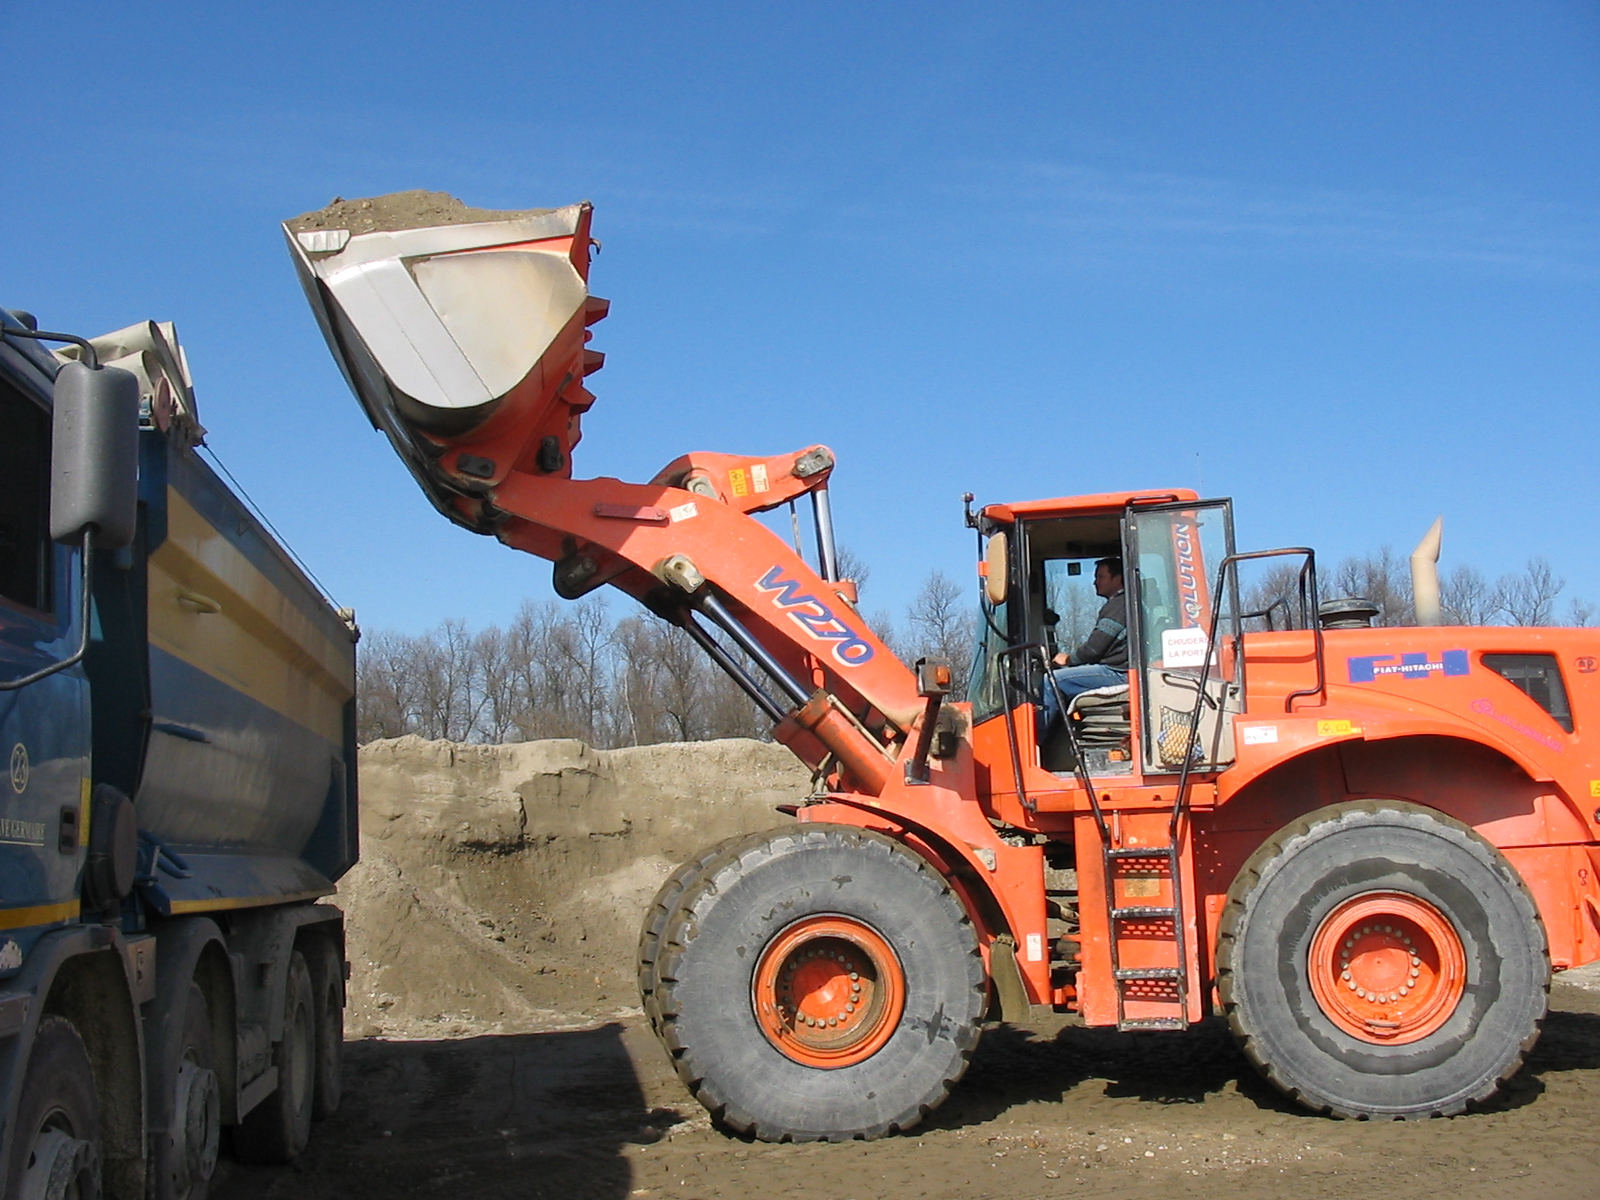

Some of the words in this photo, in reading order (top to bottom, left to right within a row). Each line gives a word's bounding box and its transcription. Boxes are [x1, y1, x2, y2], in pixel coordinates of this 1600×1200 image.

[753, 565, 874, 667] W270
[1168, 650, 1180, 658] LA
[1181, 648, 1204, 657] PORT
[1373, 662, 1444, 674] FIAT-HITACHI
